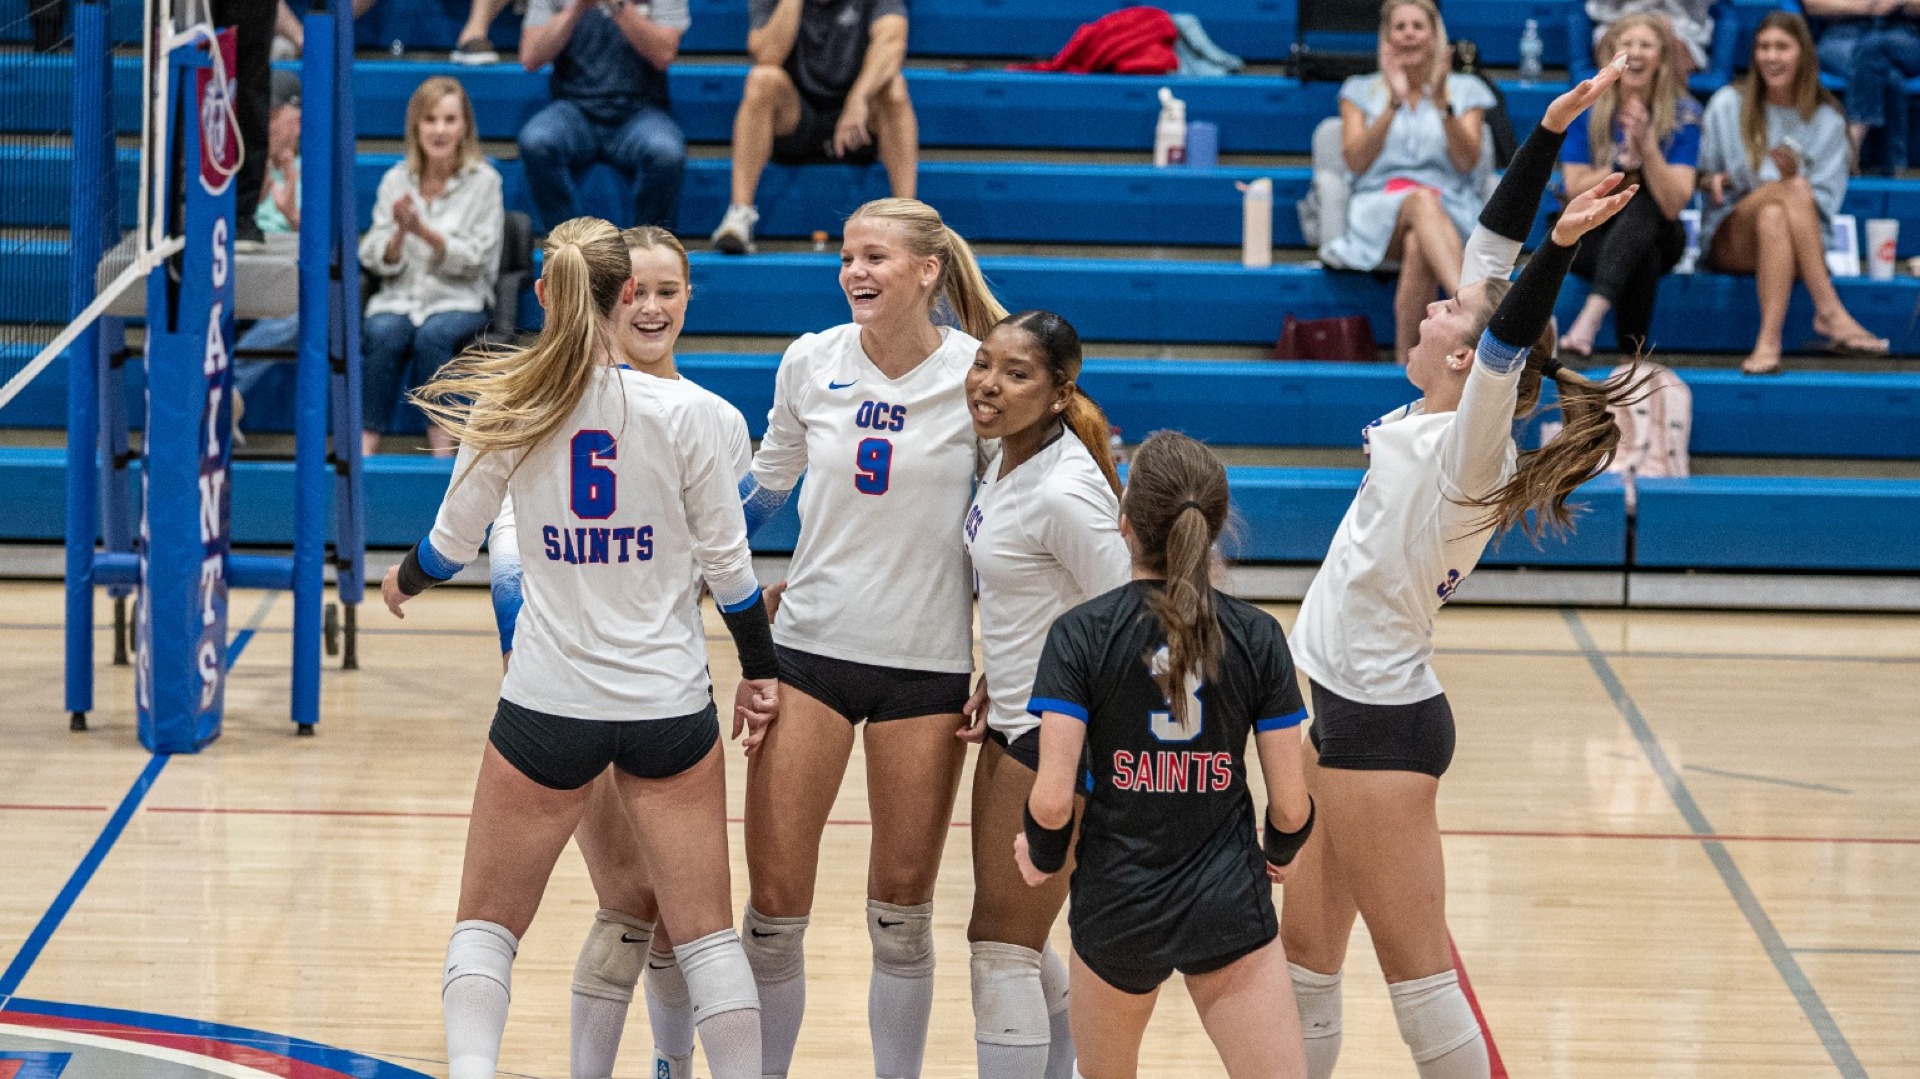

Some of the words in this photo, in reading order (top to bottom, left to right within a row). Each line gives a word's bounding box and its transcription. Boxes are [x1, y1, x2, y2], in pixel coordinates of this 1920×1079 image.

[855, 400, 907, 432] OCS
[199, 216, 228, 711] SAINTS
[570, 429, 617, 520] 6
[855, 437, 893, 496] 9
[542, 524, 654, 565] SAINTS
[1436, 568, 1466, 602] 3
[1148, 644, 1204, 743] 3
[1112, 750, 1232, 793] SAINTS
